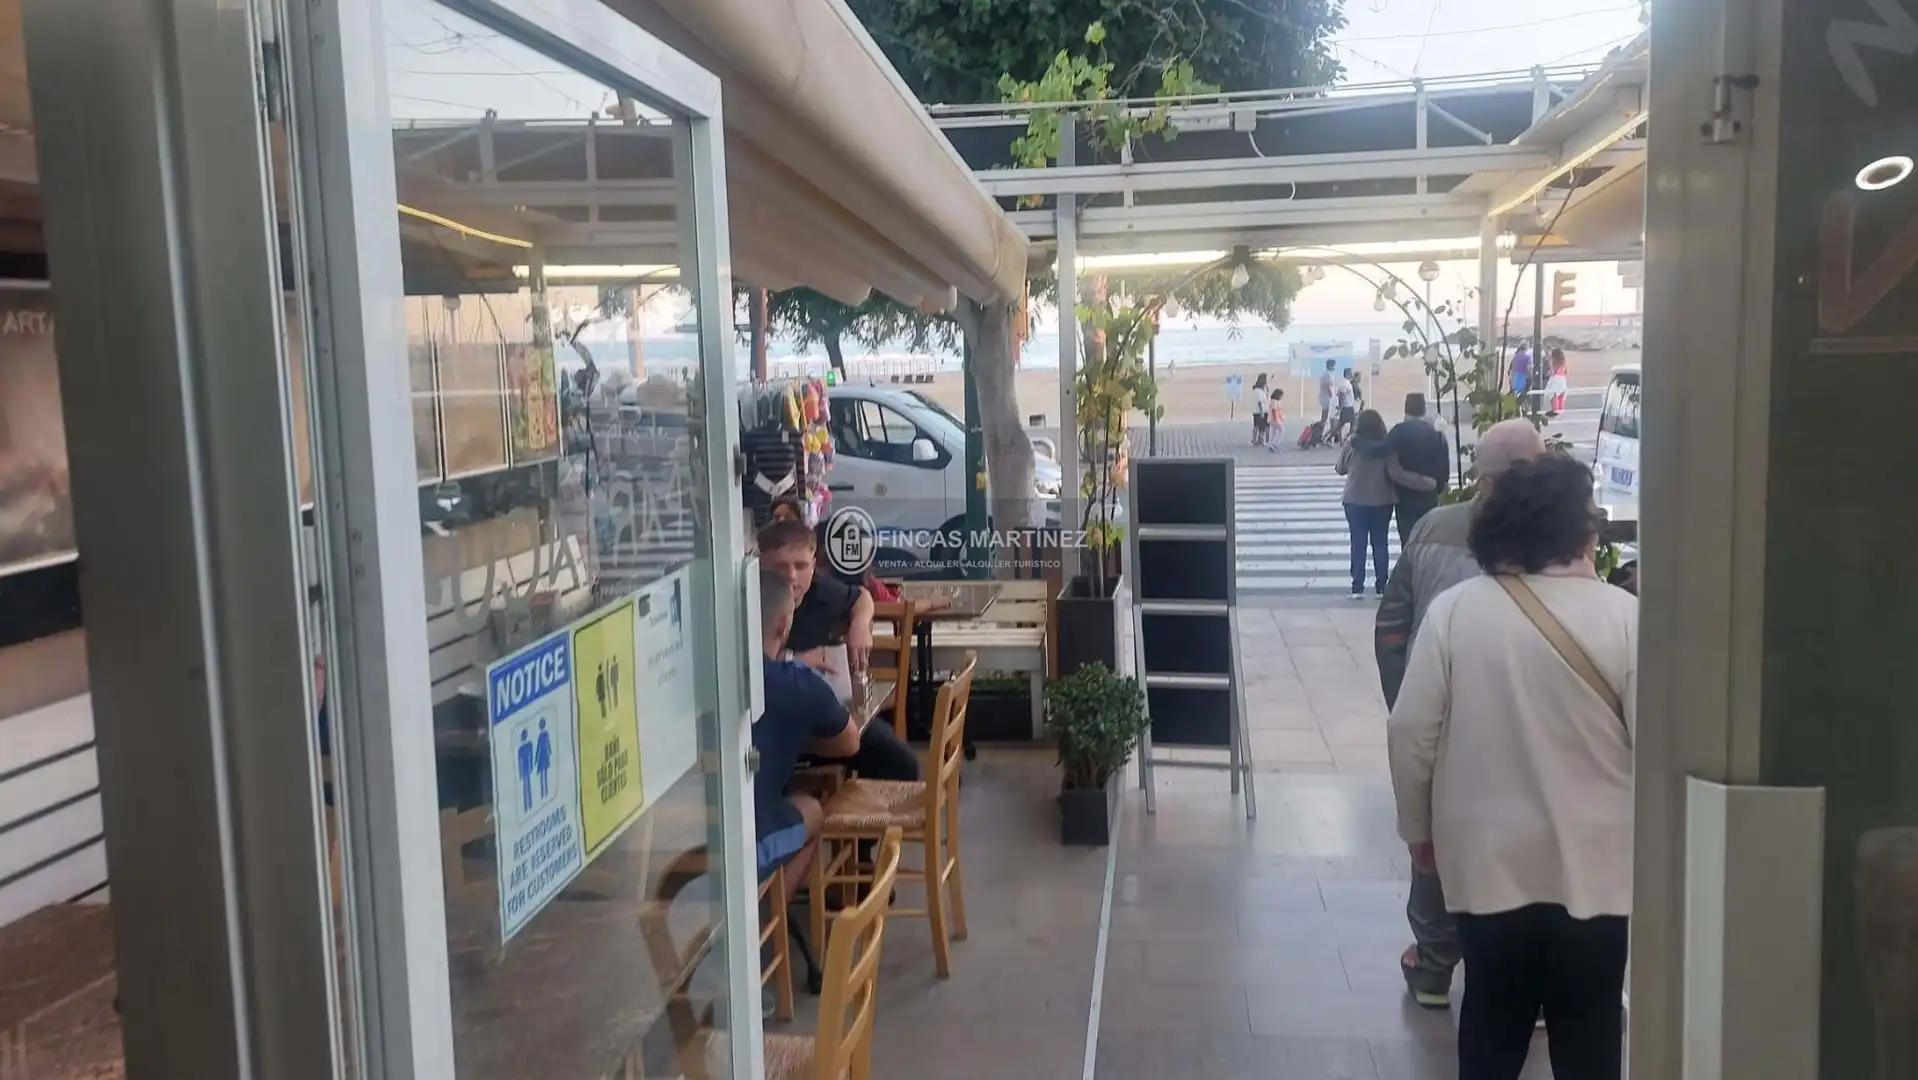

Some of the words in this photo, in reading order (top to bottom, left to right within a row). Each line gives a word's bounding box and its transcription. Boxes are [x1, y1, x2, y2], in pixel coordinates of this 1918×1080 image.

[497, 644, 565, 717] NOTICE
[510, 861, 529, 891] ARE
[531, 823, 573, 873] RESERVED
[513, 804, 566, 861] RESTROOMS
[507, 891, 526, 919] FOR
[527, 842, 578, 899] CUSTOMERS
